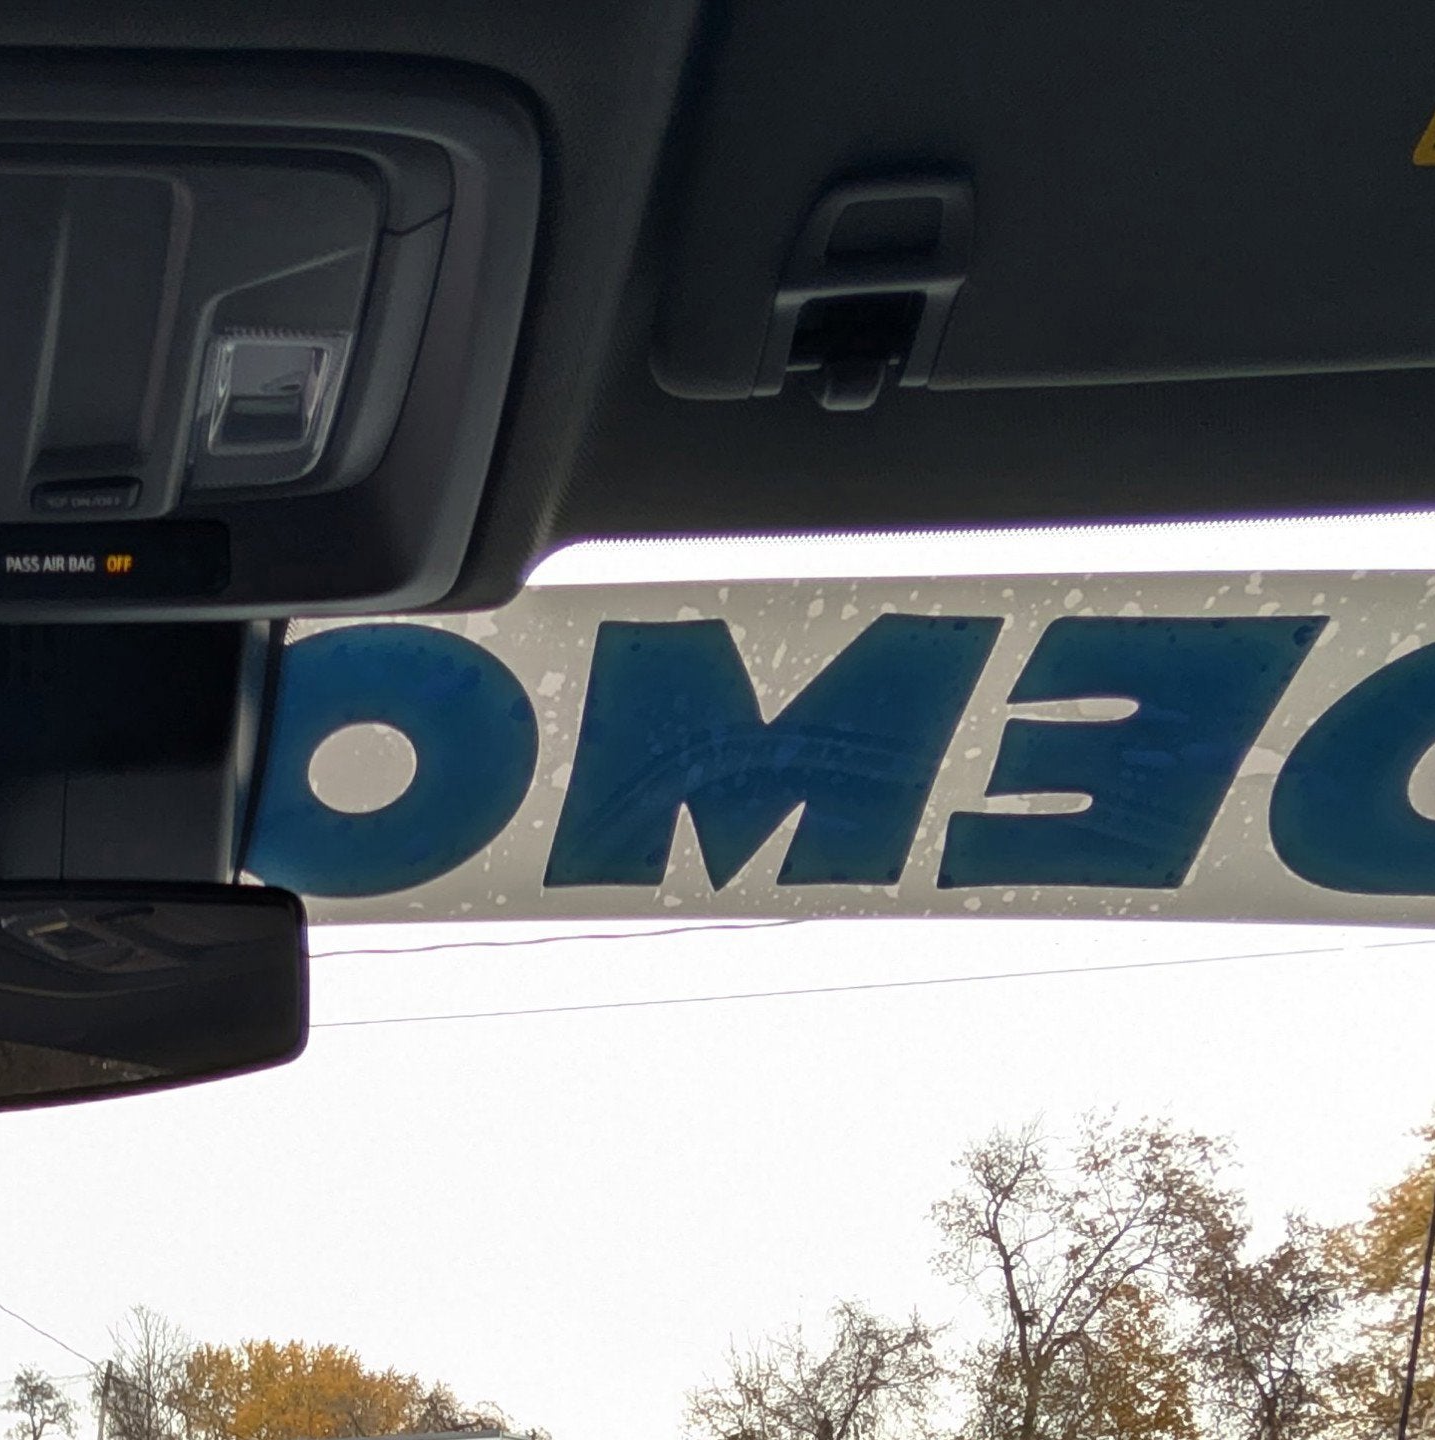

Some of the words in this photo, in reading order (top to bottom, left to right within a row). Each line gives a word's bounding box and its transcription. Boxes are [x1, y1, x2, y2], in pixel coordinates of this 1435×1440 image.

[6, 556, 40, 573] PASS
[42, 556, 65, 573] AIR
[67, 556, 96, 573] BAG
[106, 554, 133, 573] OFF
